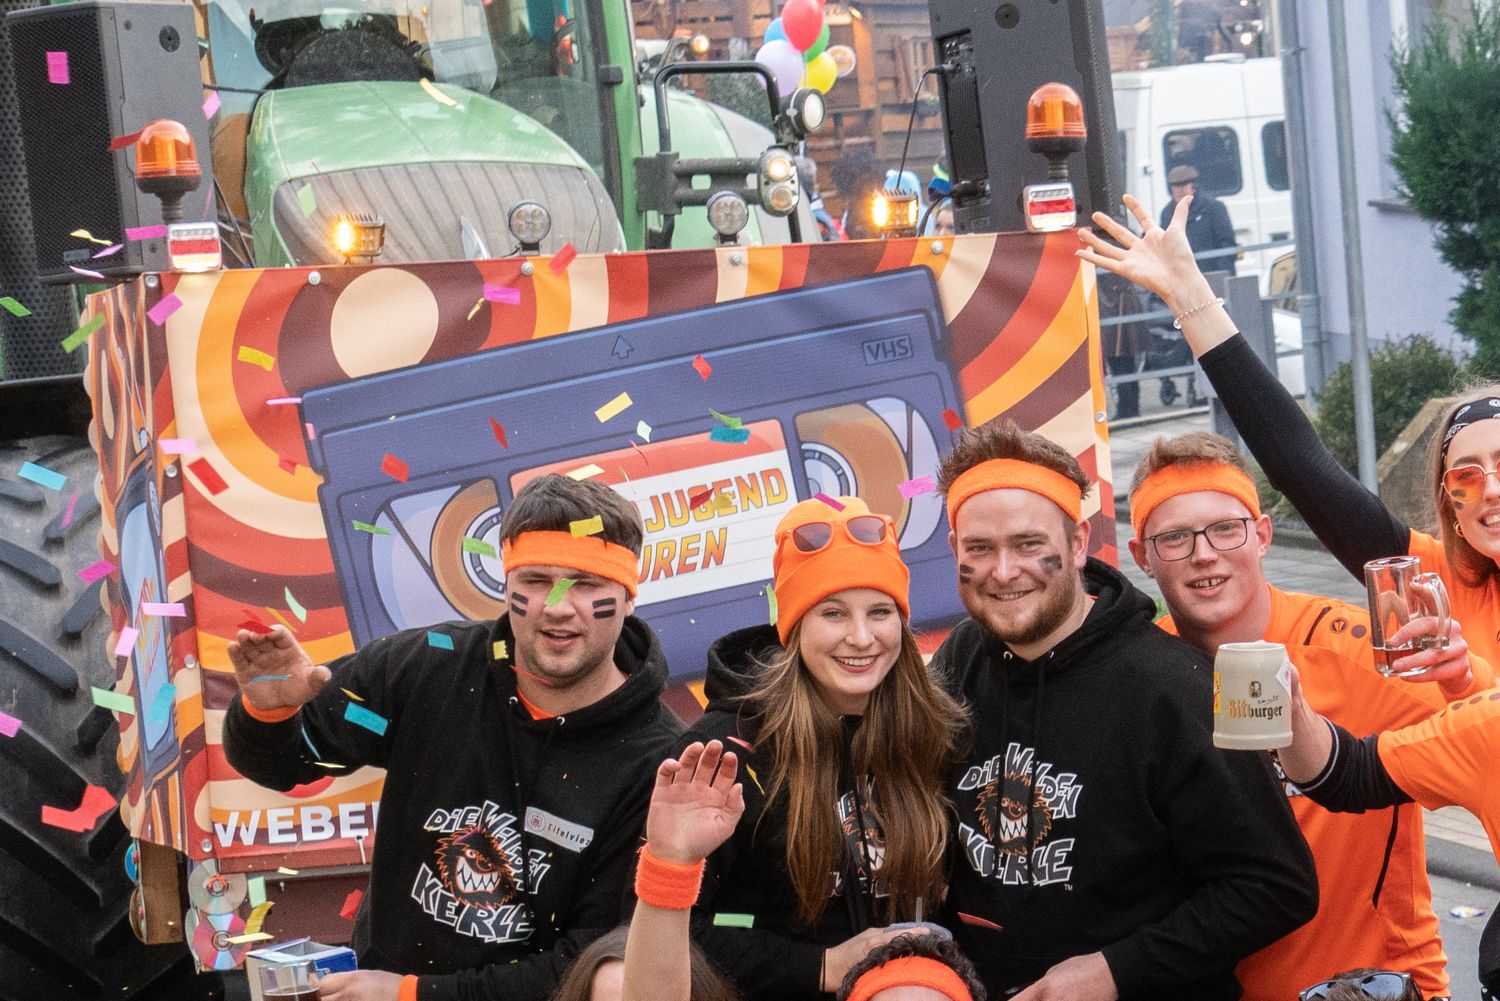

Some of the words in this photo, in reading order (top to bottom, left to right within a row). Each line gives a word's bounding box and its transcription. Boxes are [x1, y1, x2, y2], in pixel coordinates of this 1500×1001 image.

[866, 338, 909, 361] VHS
[1228, 698, 1283, 720] Bitburger
[213, 800, 380, 848] WEBE
[958, 822, 1076, 887] KERLE
[411, 862, 537, 943] KERLE
